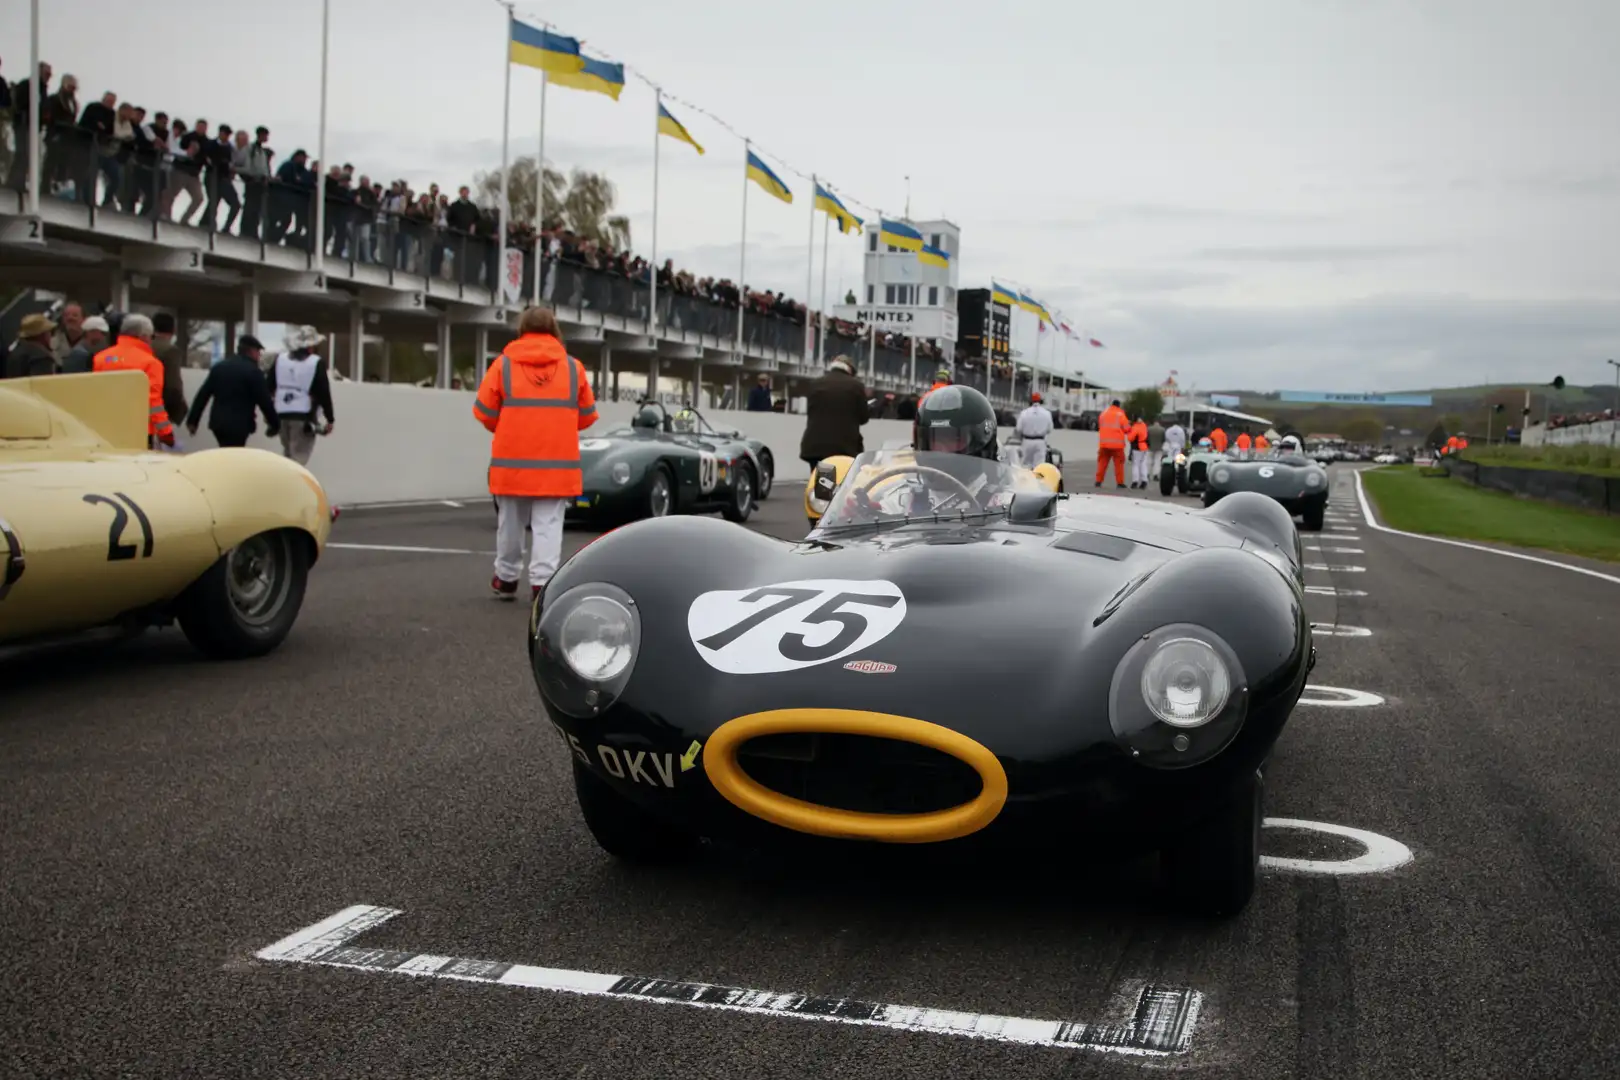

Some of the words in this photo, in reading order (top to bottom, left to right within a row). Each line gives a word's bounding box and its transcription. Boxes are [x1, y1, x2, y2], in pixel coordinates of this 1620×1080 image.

[28, 220, 39, 238] 2
[189, 252, 198, 267] 3
[314, 275, 323, 289] 4
[414, 294, 422, 307] 5
[495, 309, 503, 321] 6
[857, 310, 914, 322] MINTEX
[1258, 466, 1275, 478] 6
[82, 492, 154, 561] 21
[696, 587, 902, 662] 75
[845, 661, 897, 673] JAGUAR
[597, 744, 675, 788] OKV
